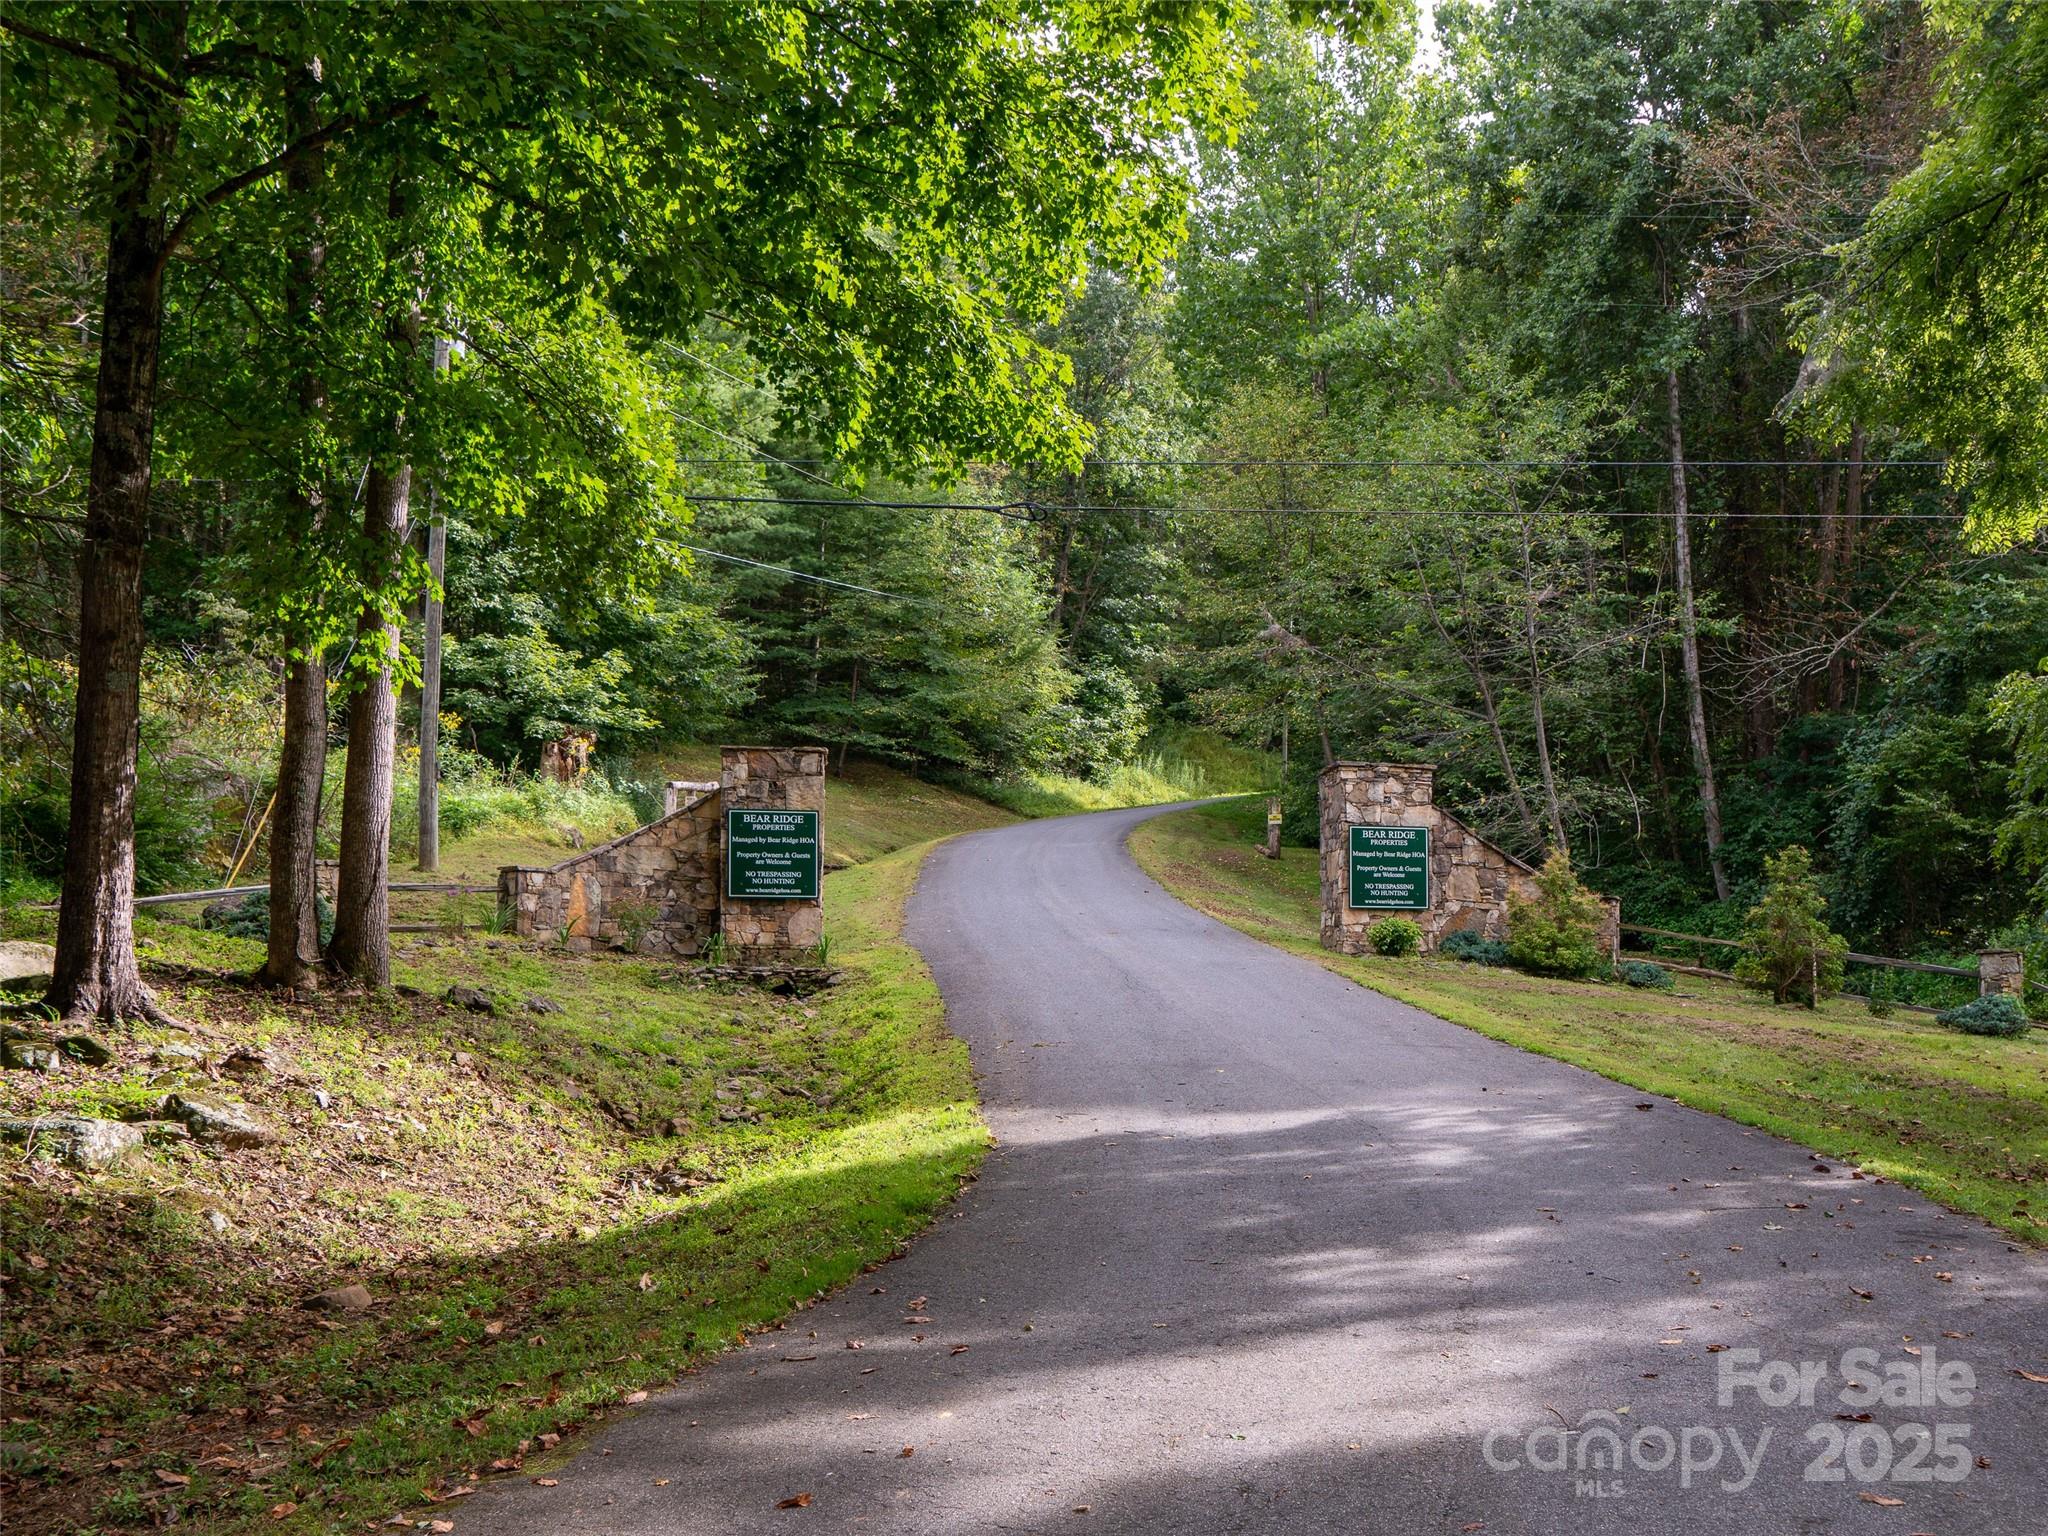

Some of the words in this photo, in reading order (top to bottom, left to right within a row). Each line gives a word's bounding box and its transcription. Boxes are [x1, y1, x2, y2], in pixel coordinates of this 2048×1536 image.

[743, 814, 770, 823] BEAR
[773, 815, 804, 823] RIDGE
[1363, 830, 1386, 838] BEAR
[1388, 831, 1415, 839] RIDGE
